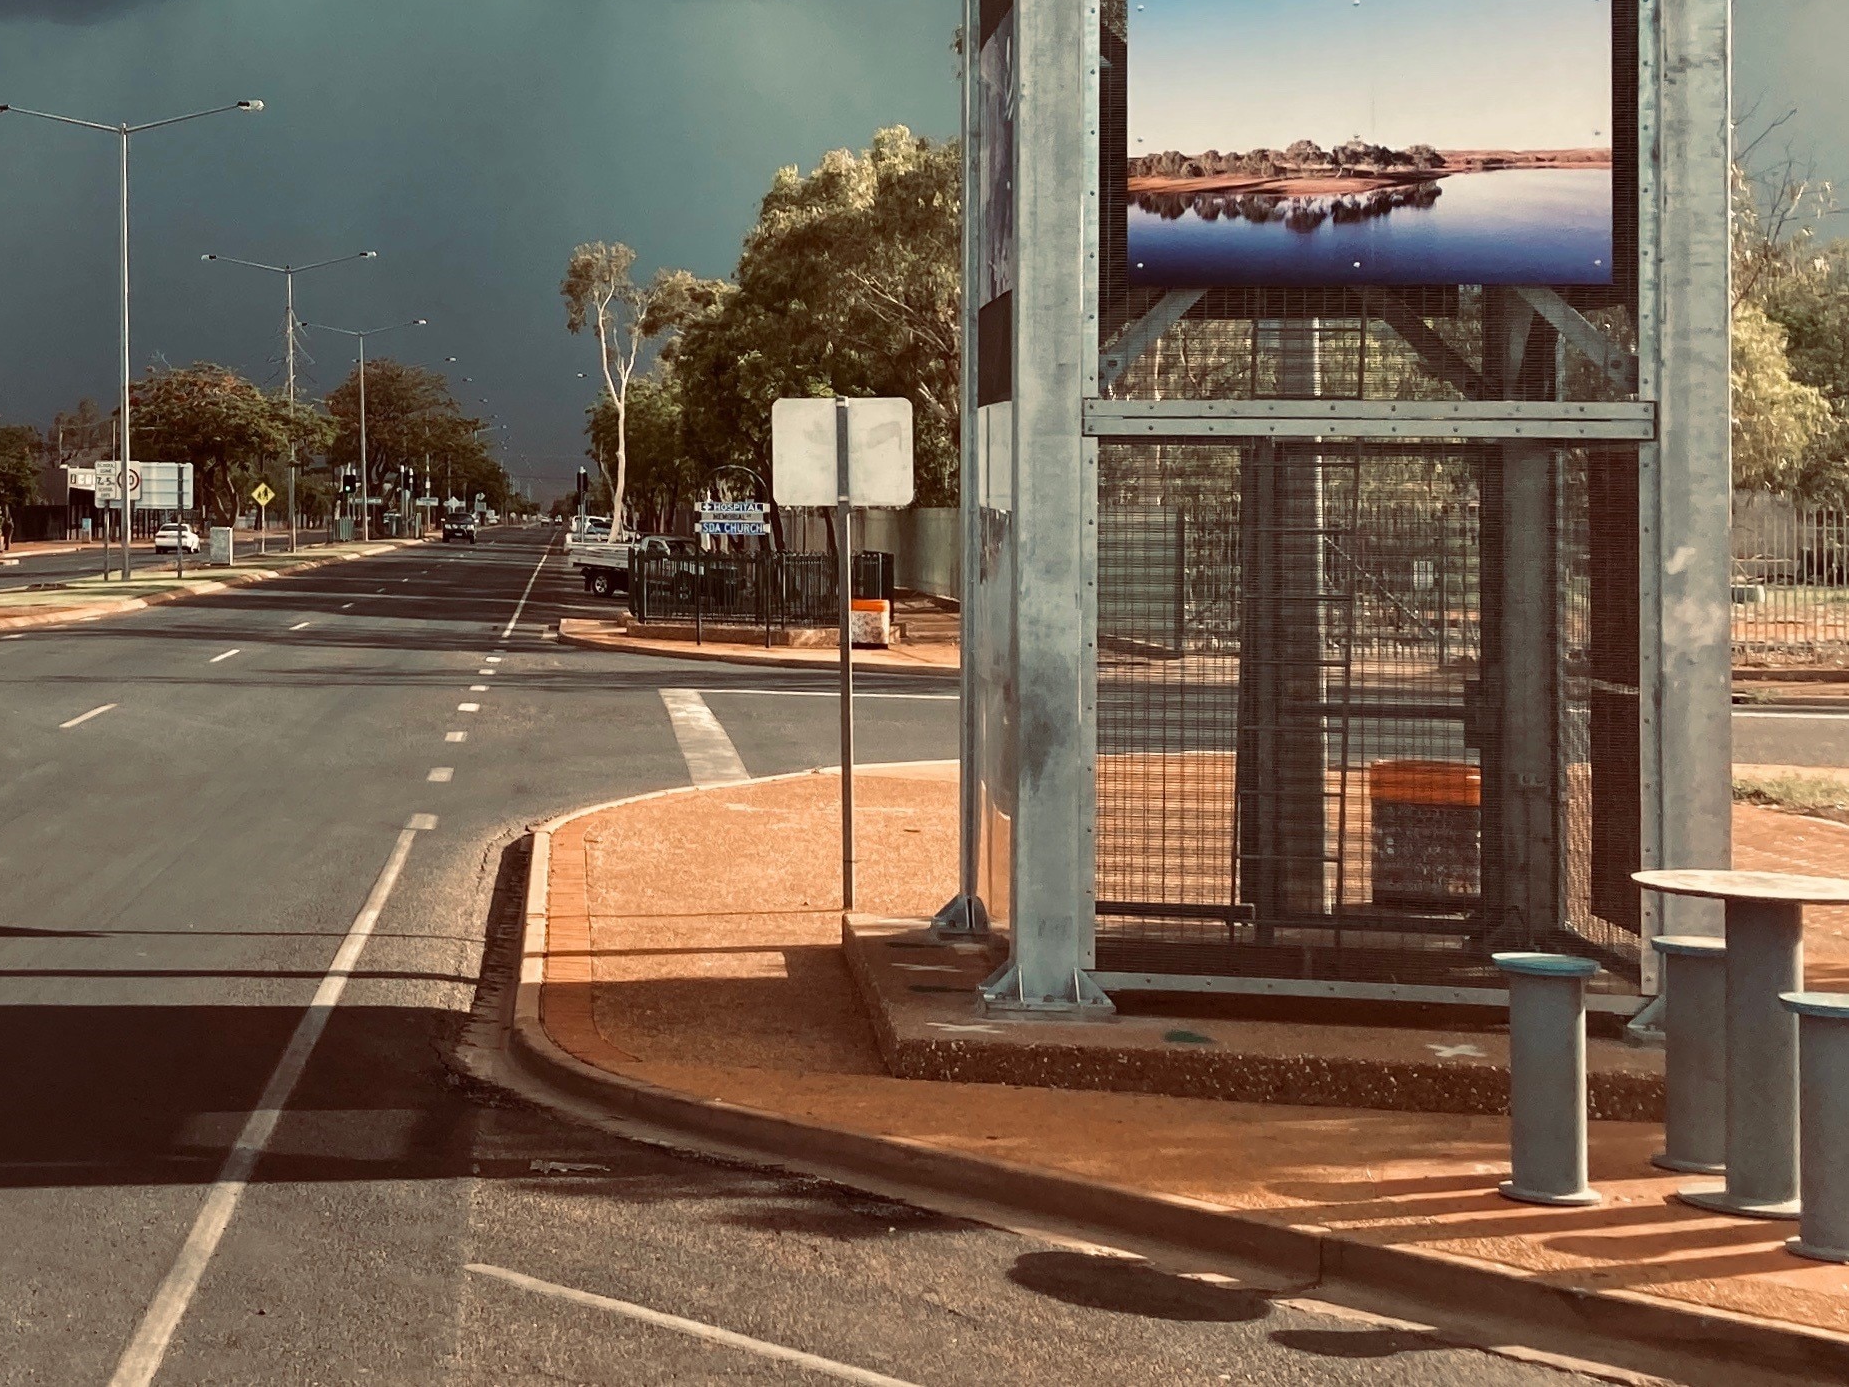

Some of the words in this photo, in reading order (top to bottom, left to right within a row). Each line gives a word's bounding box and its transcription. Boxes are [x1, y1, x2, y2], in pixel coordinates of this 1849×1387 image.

[713, 503, 760, 512] HOSPITAL
[703, 522, 721, 533] SDA
[724, 523, 763, 533] CHURCH
